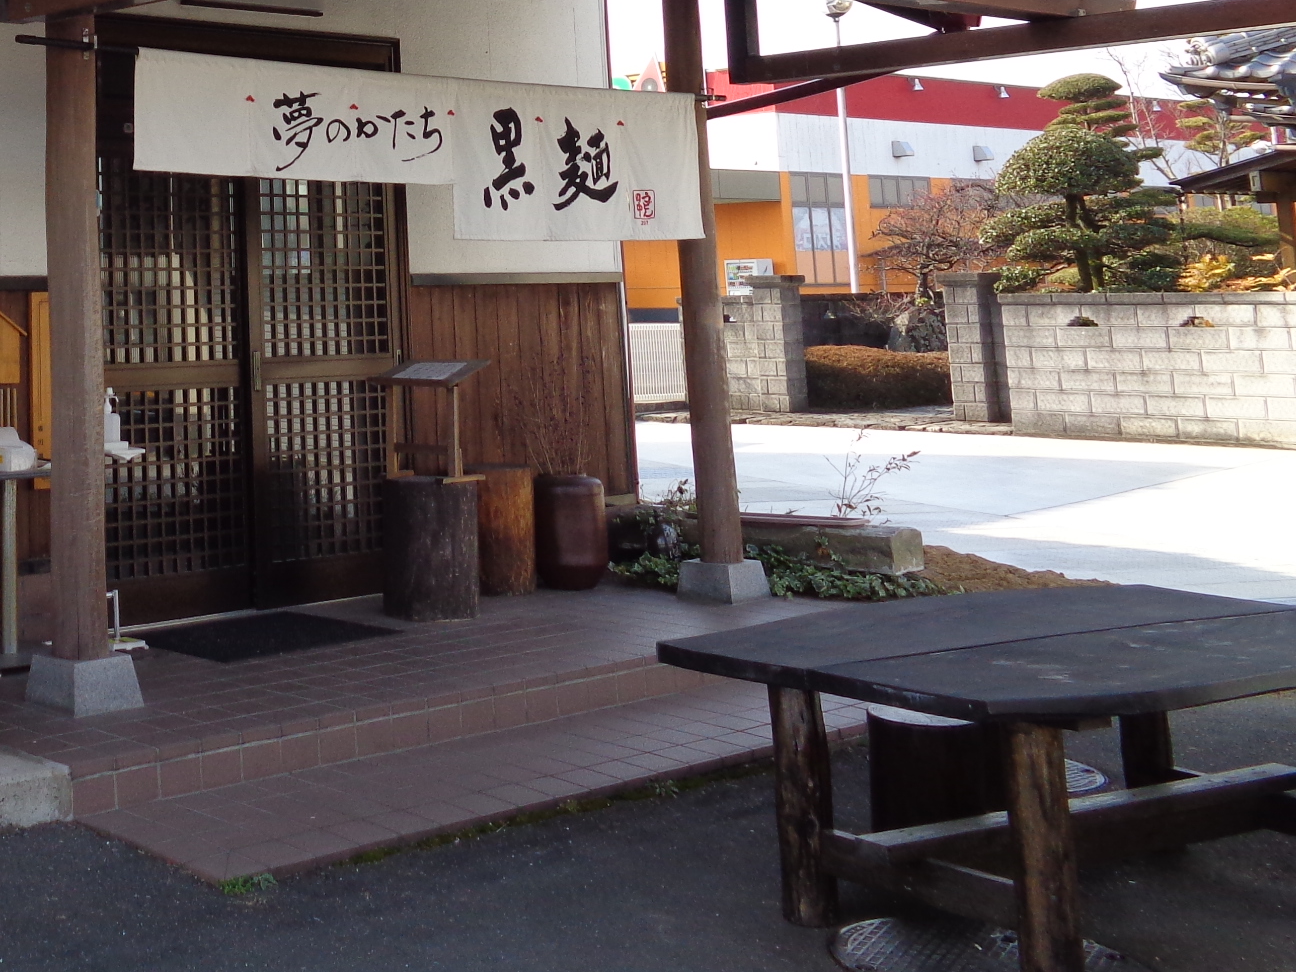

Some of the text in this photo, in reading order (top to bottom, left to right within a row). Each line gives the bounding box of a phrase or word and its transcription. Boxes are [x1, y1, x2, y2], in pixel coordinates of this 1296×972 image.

[272, 91, 444, 172] 夢のかたち
